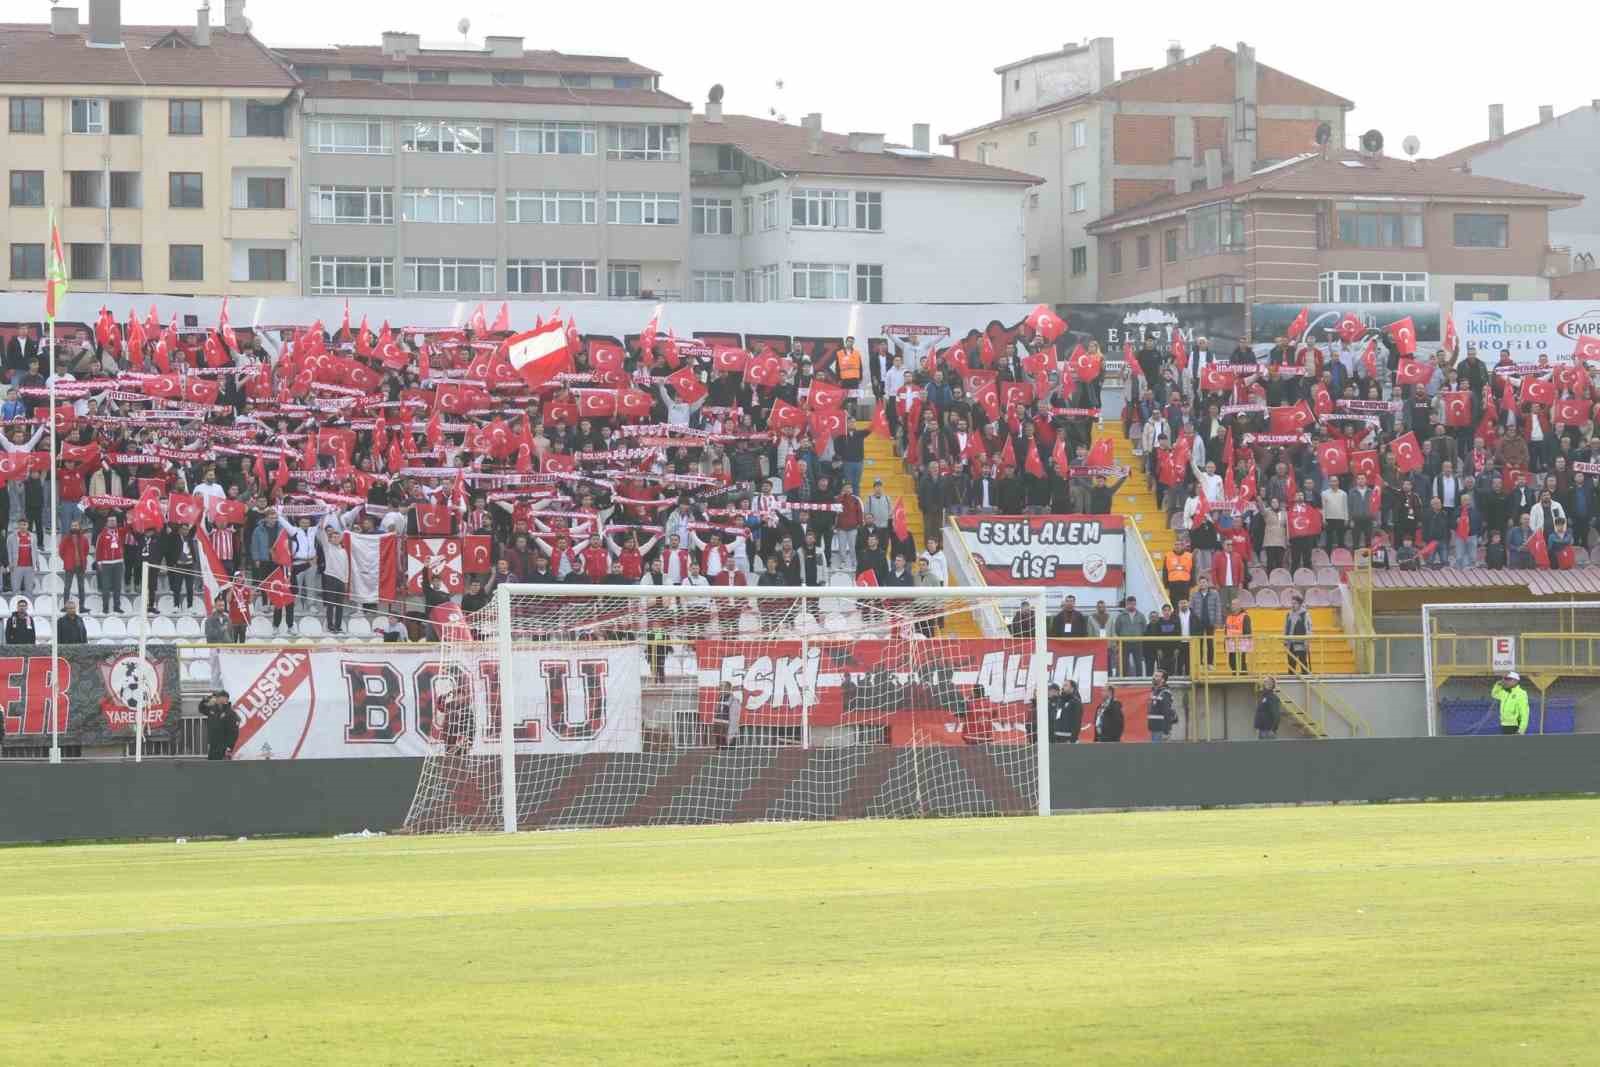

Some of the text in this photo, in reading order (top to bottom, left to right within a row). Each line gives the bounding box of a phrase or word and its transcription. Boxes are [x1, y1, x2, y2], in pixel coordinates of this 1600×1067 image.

[1038, 521, 1102, 545] ALEM
[1496, 639, 1509, 654] E
[257, 690, 285, 721] 1965
[340, 658, 609, 744] BOLU
